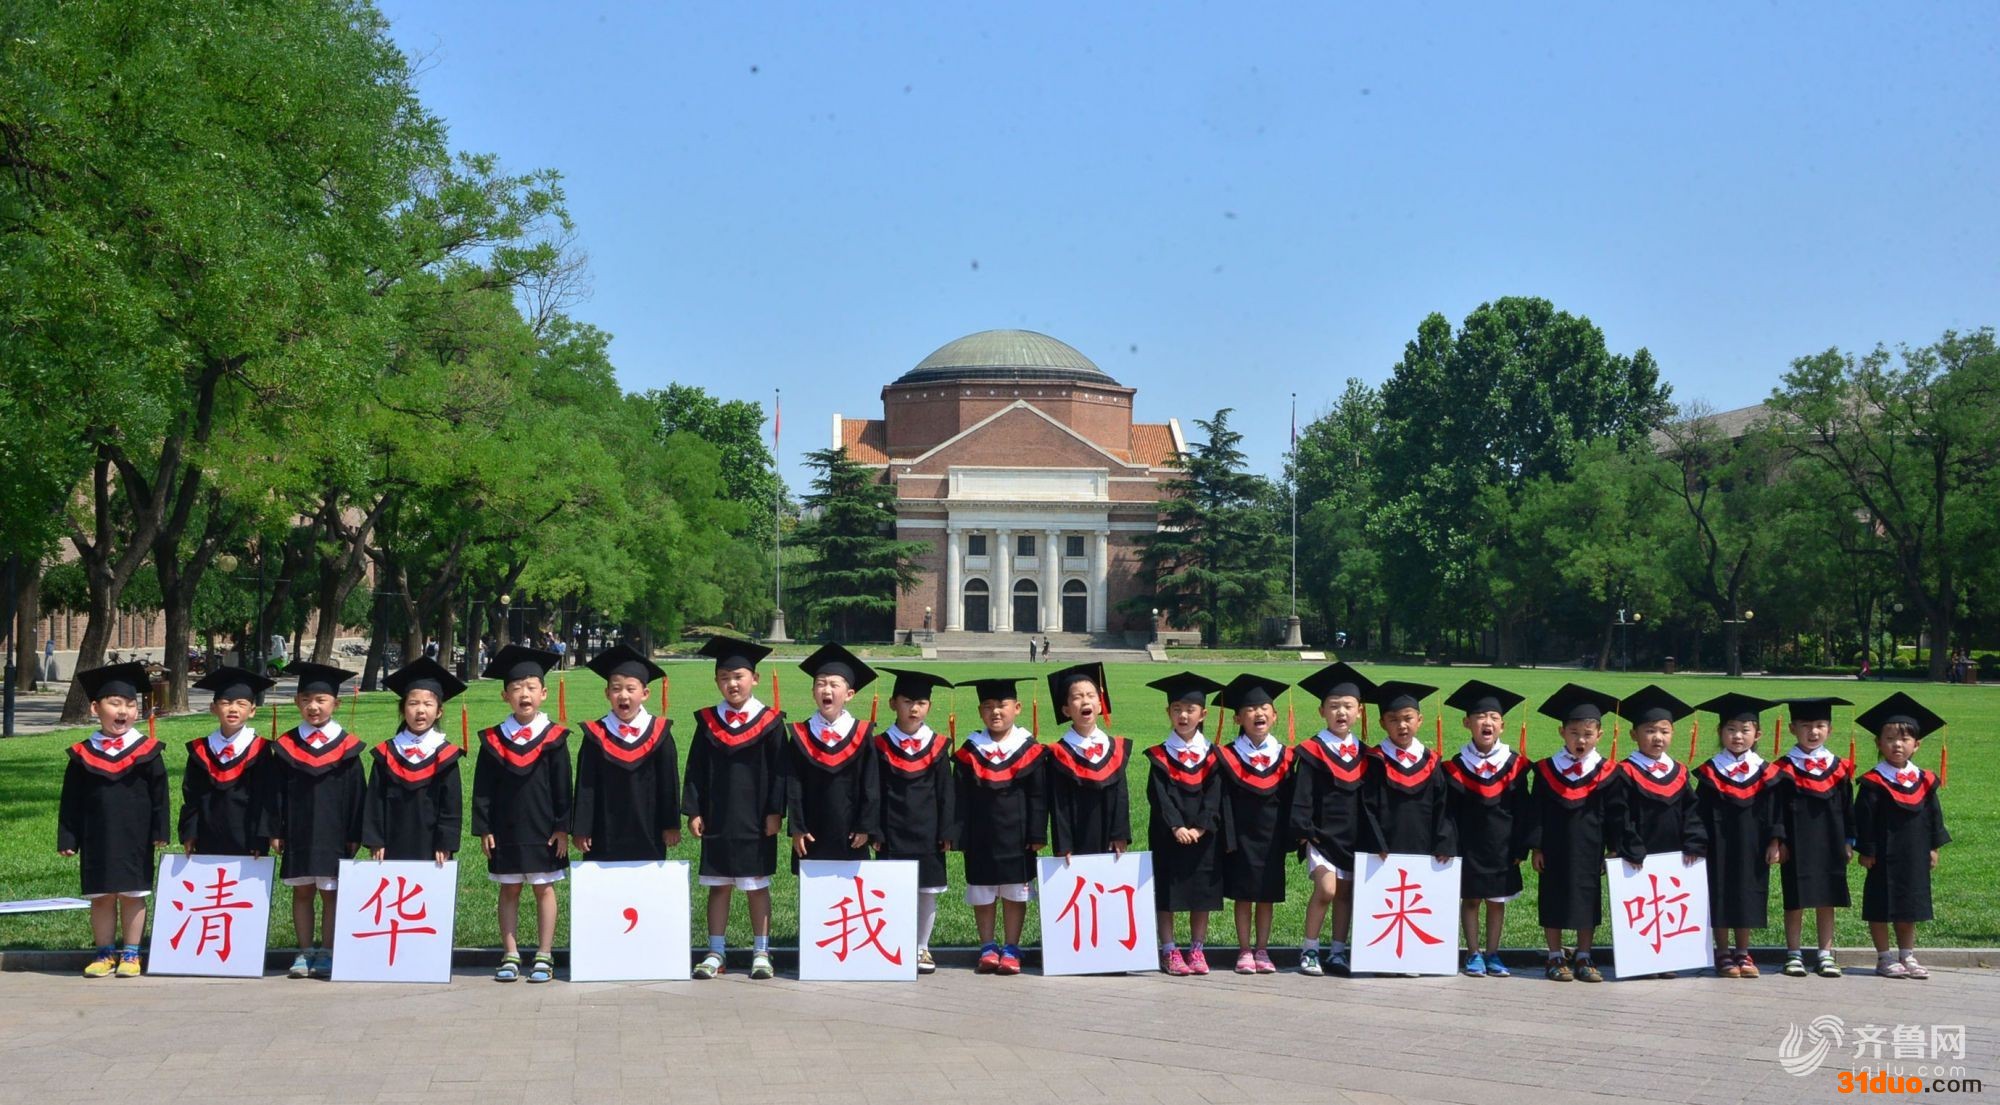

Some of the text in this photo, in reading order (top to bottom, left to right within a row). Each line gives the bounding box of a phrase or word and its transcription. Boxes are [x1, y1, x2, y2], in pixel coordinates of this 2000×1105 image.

[170, 867, 253, 963] 清
[353, 876, 437, 966] 华
[815, 876, 902, 966] 我
[1055, 876, 1138, 952] 们
[1367, 868, 1444, 959] 来
[1623, 874, 1701, 954] 啦
